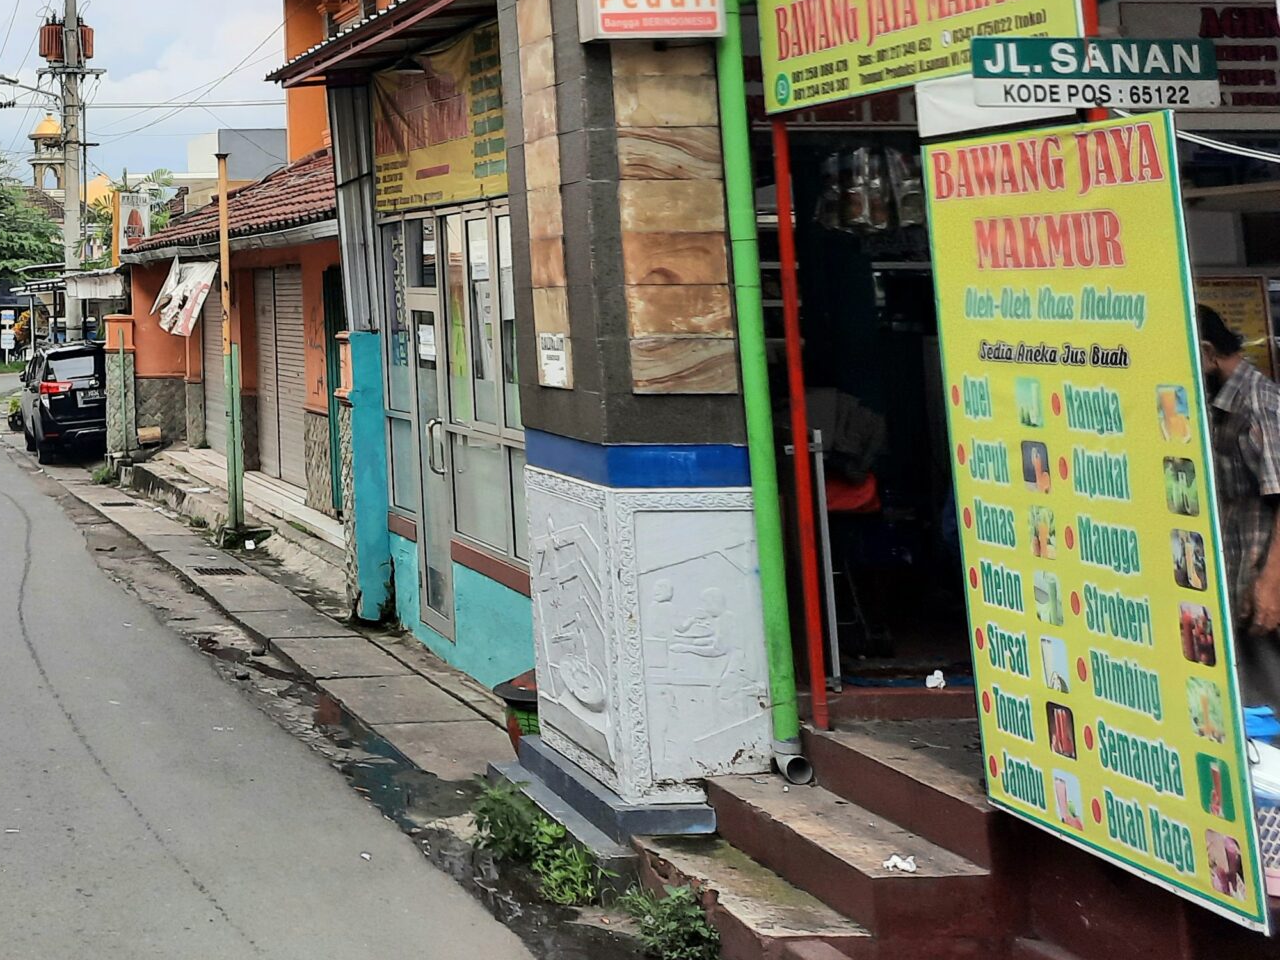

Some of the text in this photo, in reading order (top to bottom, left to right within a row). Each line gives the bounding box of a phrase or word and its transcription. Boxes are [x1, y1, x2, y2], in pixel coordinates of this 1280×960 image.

[984, 43, 1043, 74] JL.
[1050, 43, 1201, 74] SANAN
[1004, 84, 1061, 103] KODE
[1068, 84, 1112, 104] POS
[1130, 86, 1190, 104] 65122
[930, 123, 1164, 200] BAWANG JAYA
[974, 208, 1125, 271] MAKMUR
[1037, 287, 1074, 320] Khas
[1080, 287, 1146, 330] Malang
[979, 340, 1130, 367] Sedia Aneka Jus Buah
[969, 439, 1010, 484] Jeruk
[973, 498, 1016, 549] Nanas
[1077, 514, 1141, 575] Mangga
[979, 559, 1024, 613] Melon
[1083, 583, 1153, 646] Stroberi
[987, 623, 1030, 678] Sirsat
[1089, 649, 1162, 722] Blimbing
[992, 686, 1035, 742] Tomat
[1001, 751, 1047, 811] Jambu
[1097, 720, 1185, 798] Semangka
[1104, 789, 1195, 875] Buah Naga
